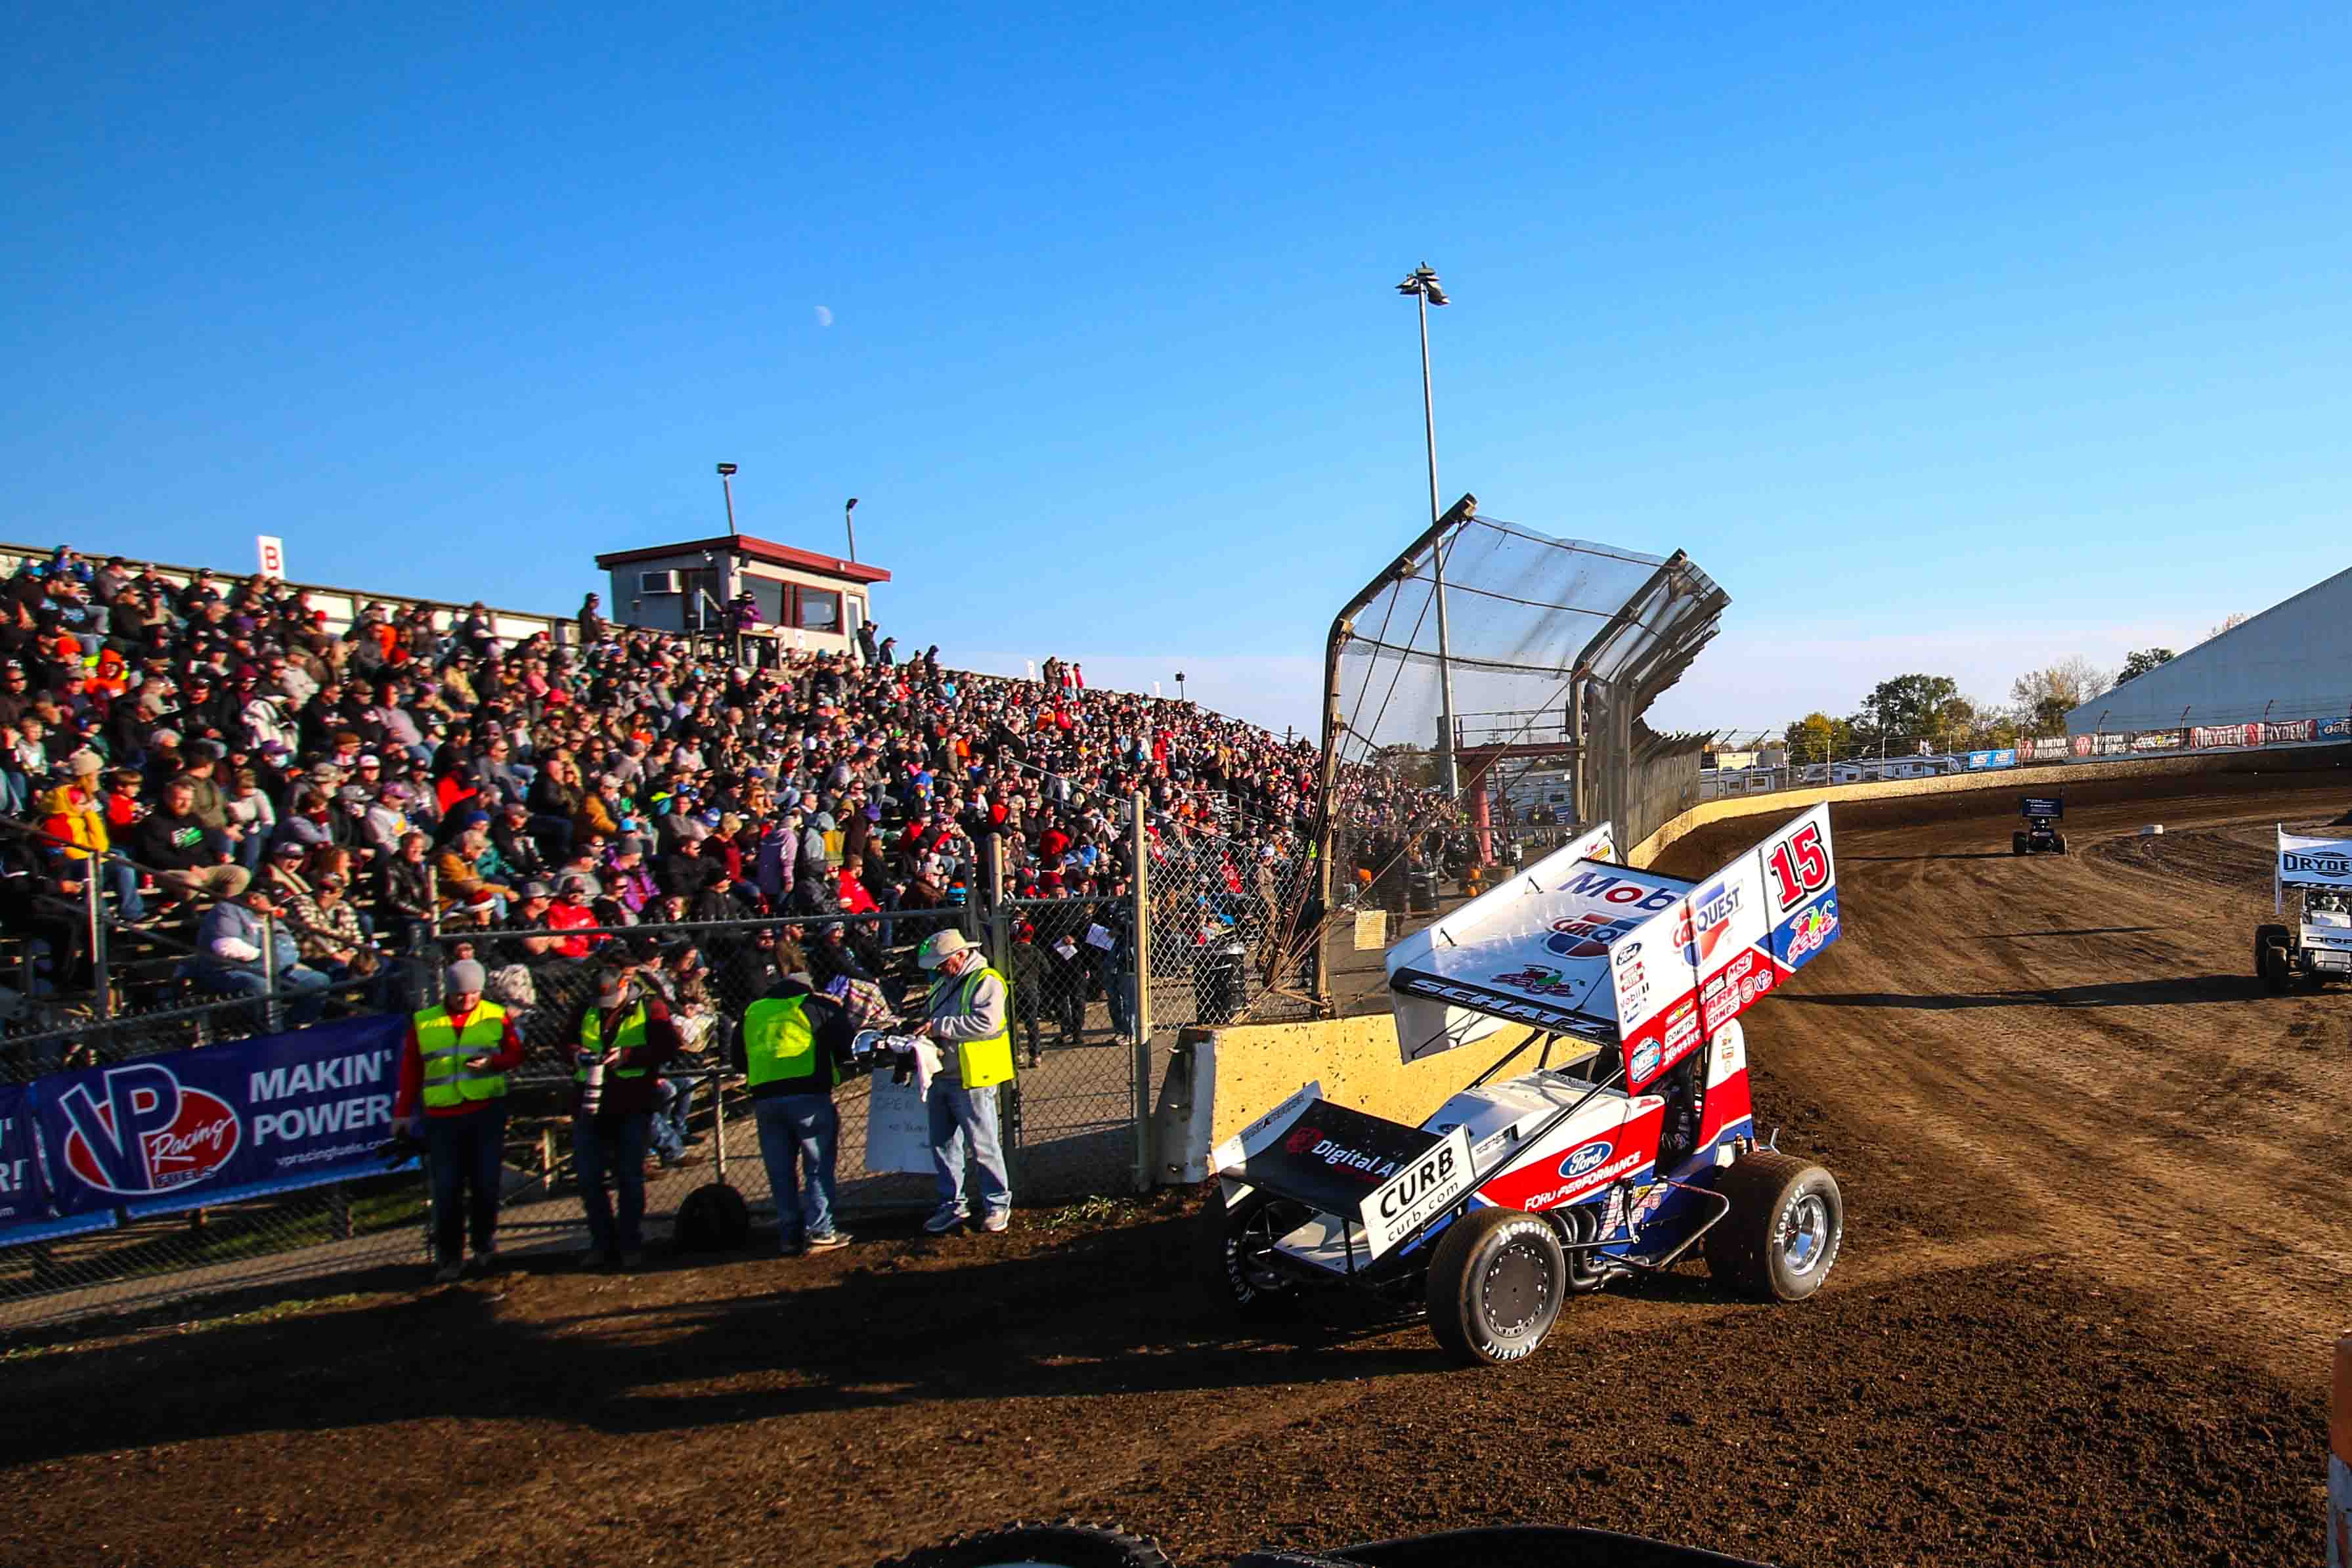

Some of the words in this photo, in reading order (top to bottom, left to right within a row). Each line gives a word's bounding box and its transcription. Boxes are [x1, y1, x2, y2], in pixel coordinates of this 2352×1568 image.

[265, 545, 280, 571] B
[2034, 747, 2069, 759] BUILDINGS
[2037, 737, 2067, 749] MORTON
[2195, 724, 2249, 749] DRYDENE
[2257, 720, 2311, 745] DRYDENE
[1767, 820, 1831, 913] 15
[1408, 978, 1615, 1039] SCHATZ
[250, 1049, 393, 1104] MAKIN'
[58, 1063, 182, 1190] VP
[149, 1116, 234, 1174] Racing
[1312, 1139, 1382, 1172] Digital
[1557, 1150, 1642, 1199] PERFORMANCE
[1569, 1147, 1603, 1175] Ford
[1380, 1146, 1454, 1219] CURB
[1387, 1181, 1459, 1243] curb.com
